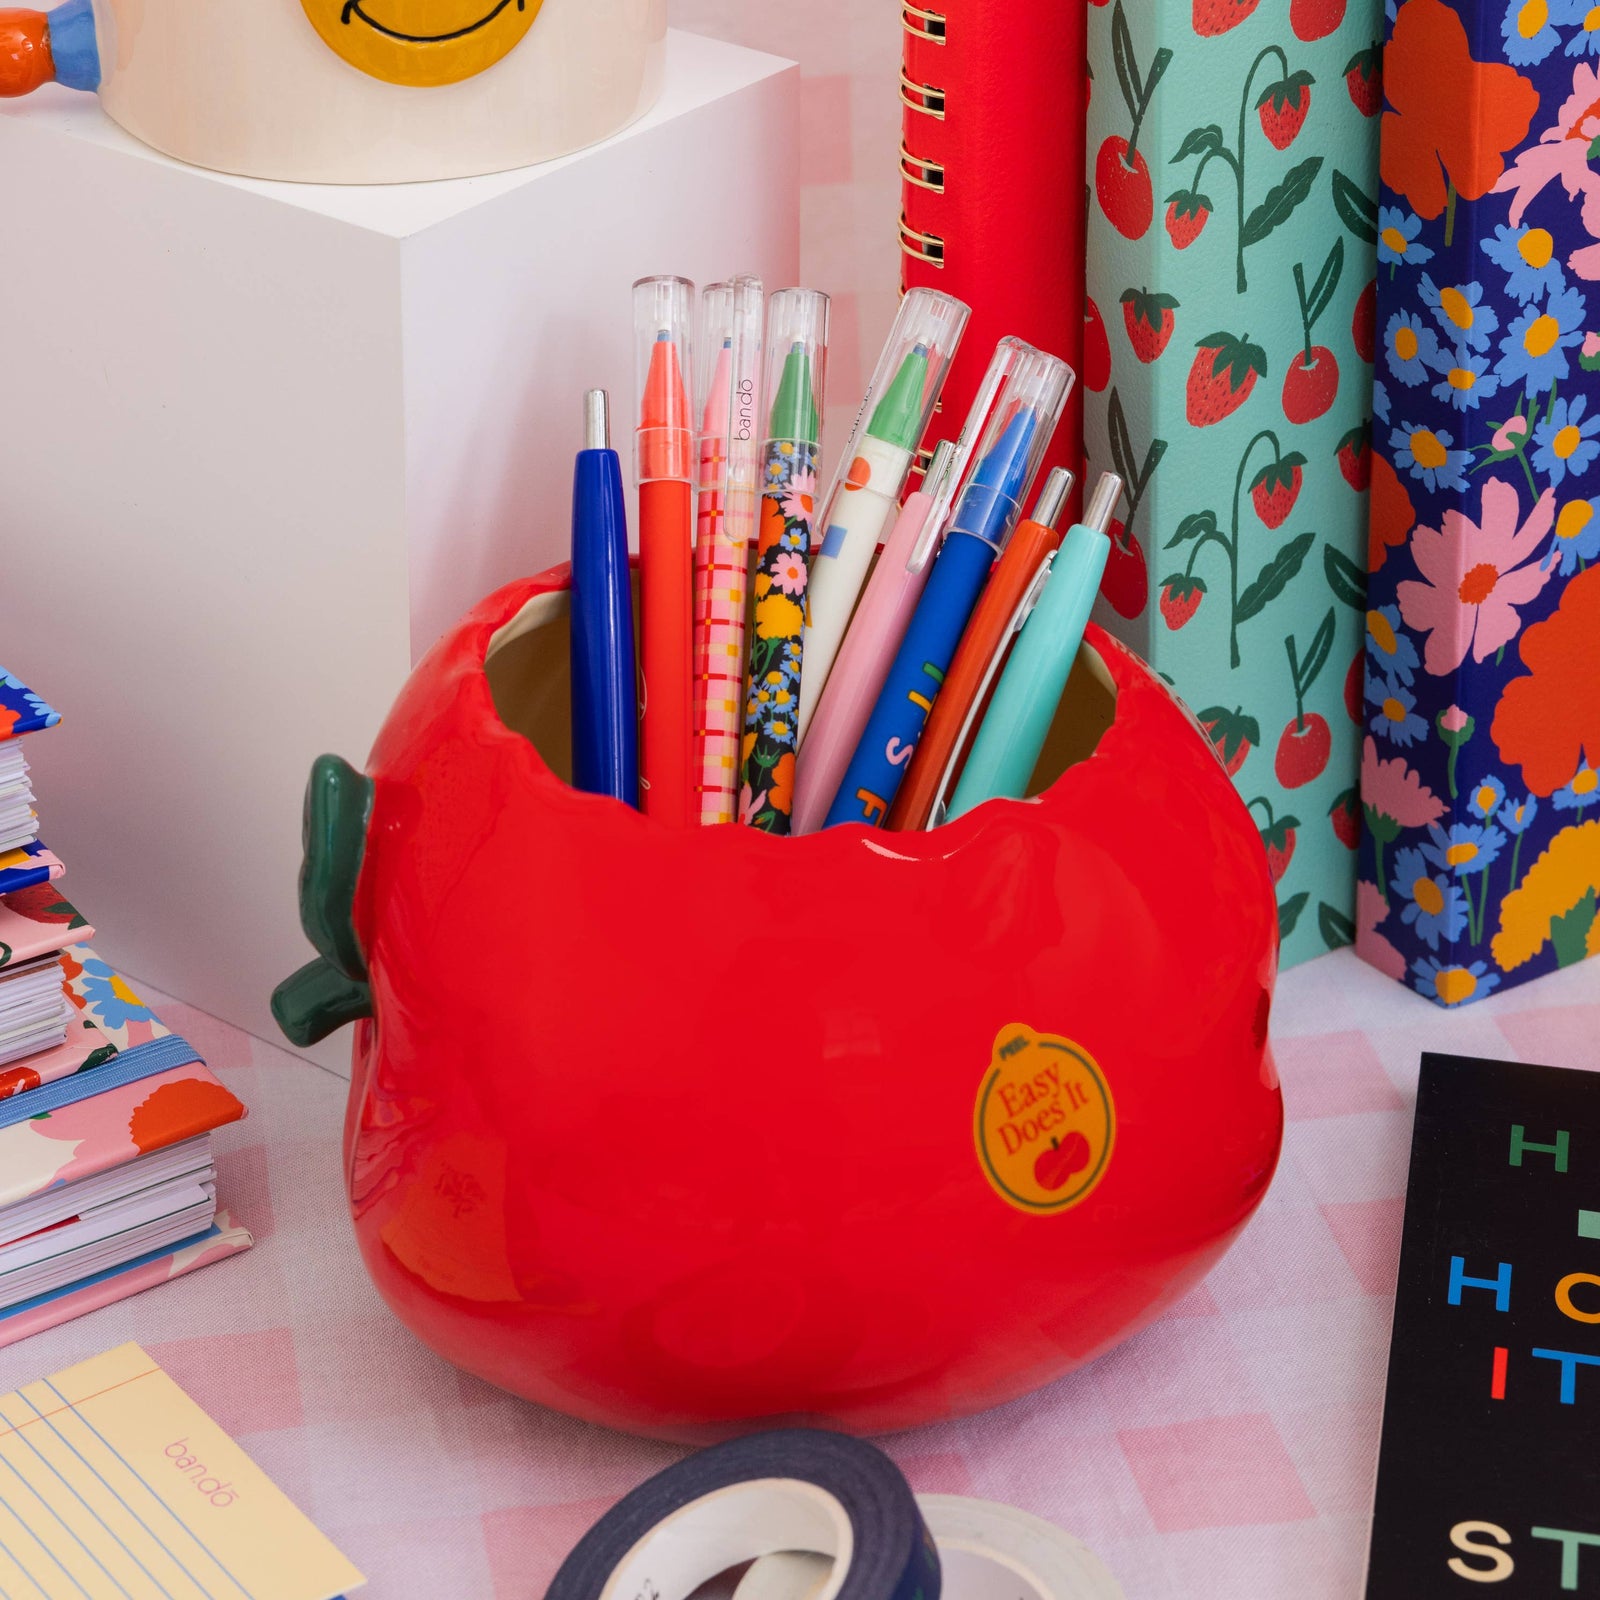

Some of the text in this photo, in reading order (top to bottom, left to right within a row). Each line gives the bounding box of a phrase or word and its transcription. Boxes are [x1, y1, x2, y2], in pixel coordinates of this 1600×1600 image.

[996, 1061, 1062, 1119] Easy
[997, 1080, 1090, 1156] Does It
[1490, 1346, 1600, 1406] IT
[1446, 1520, 1600, 1591] ST
